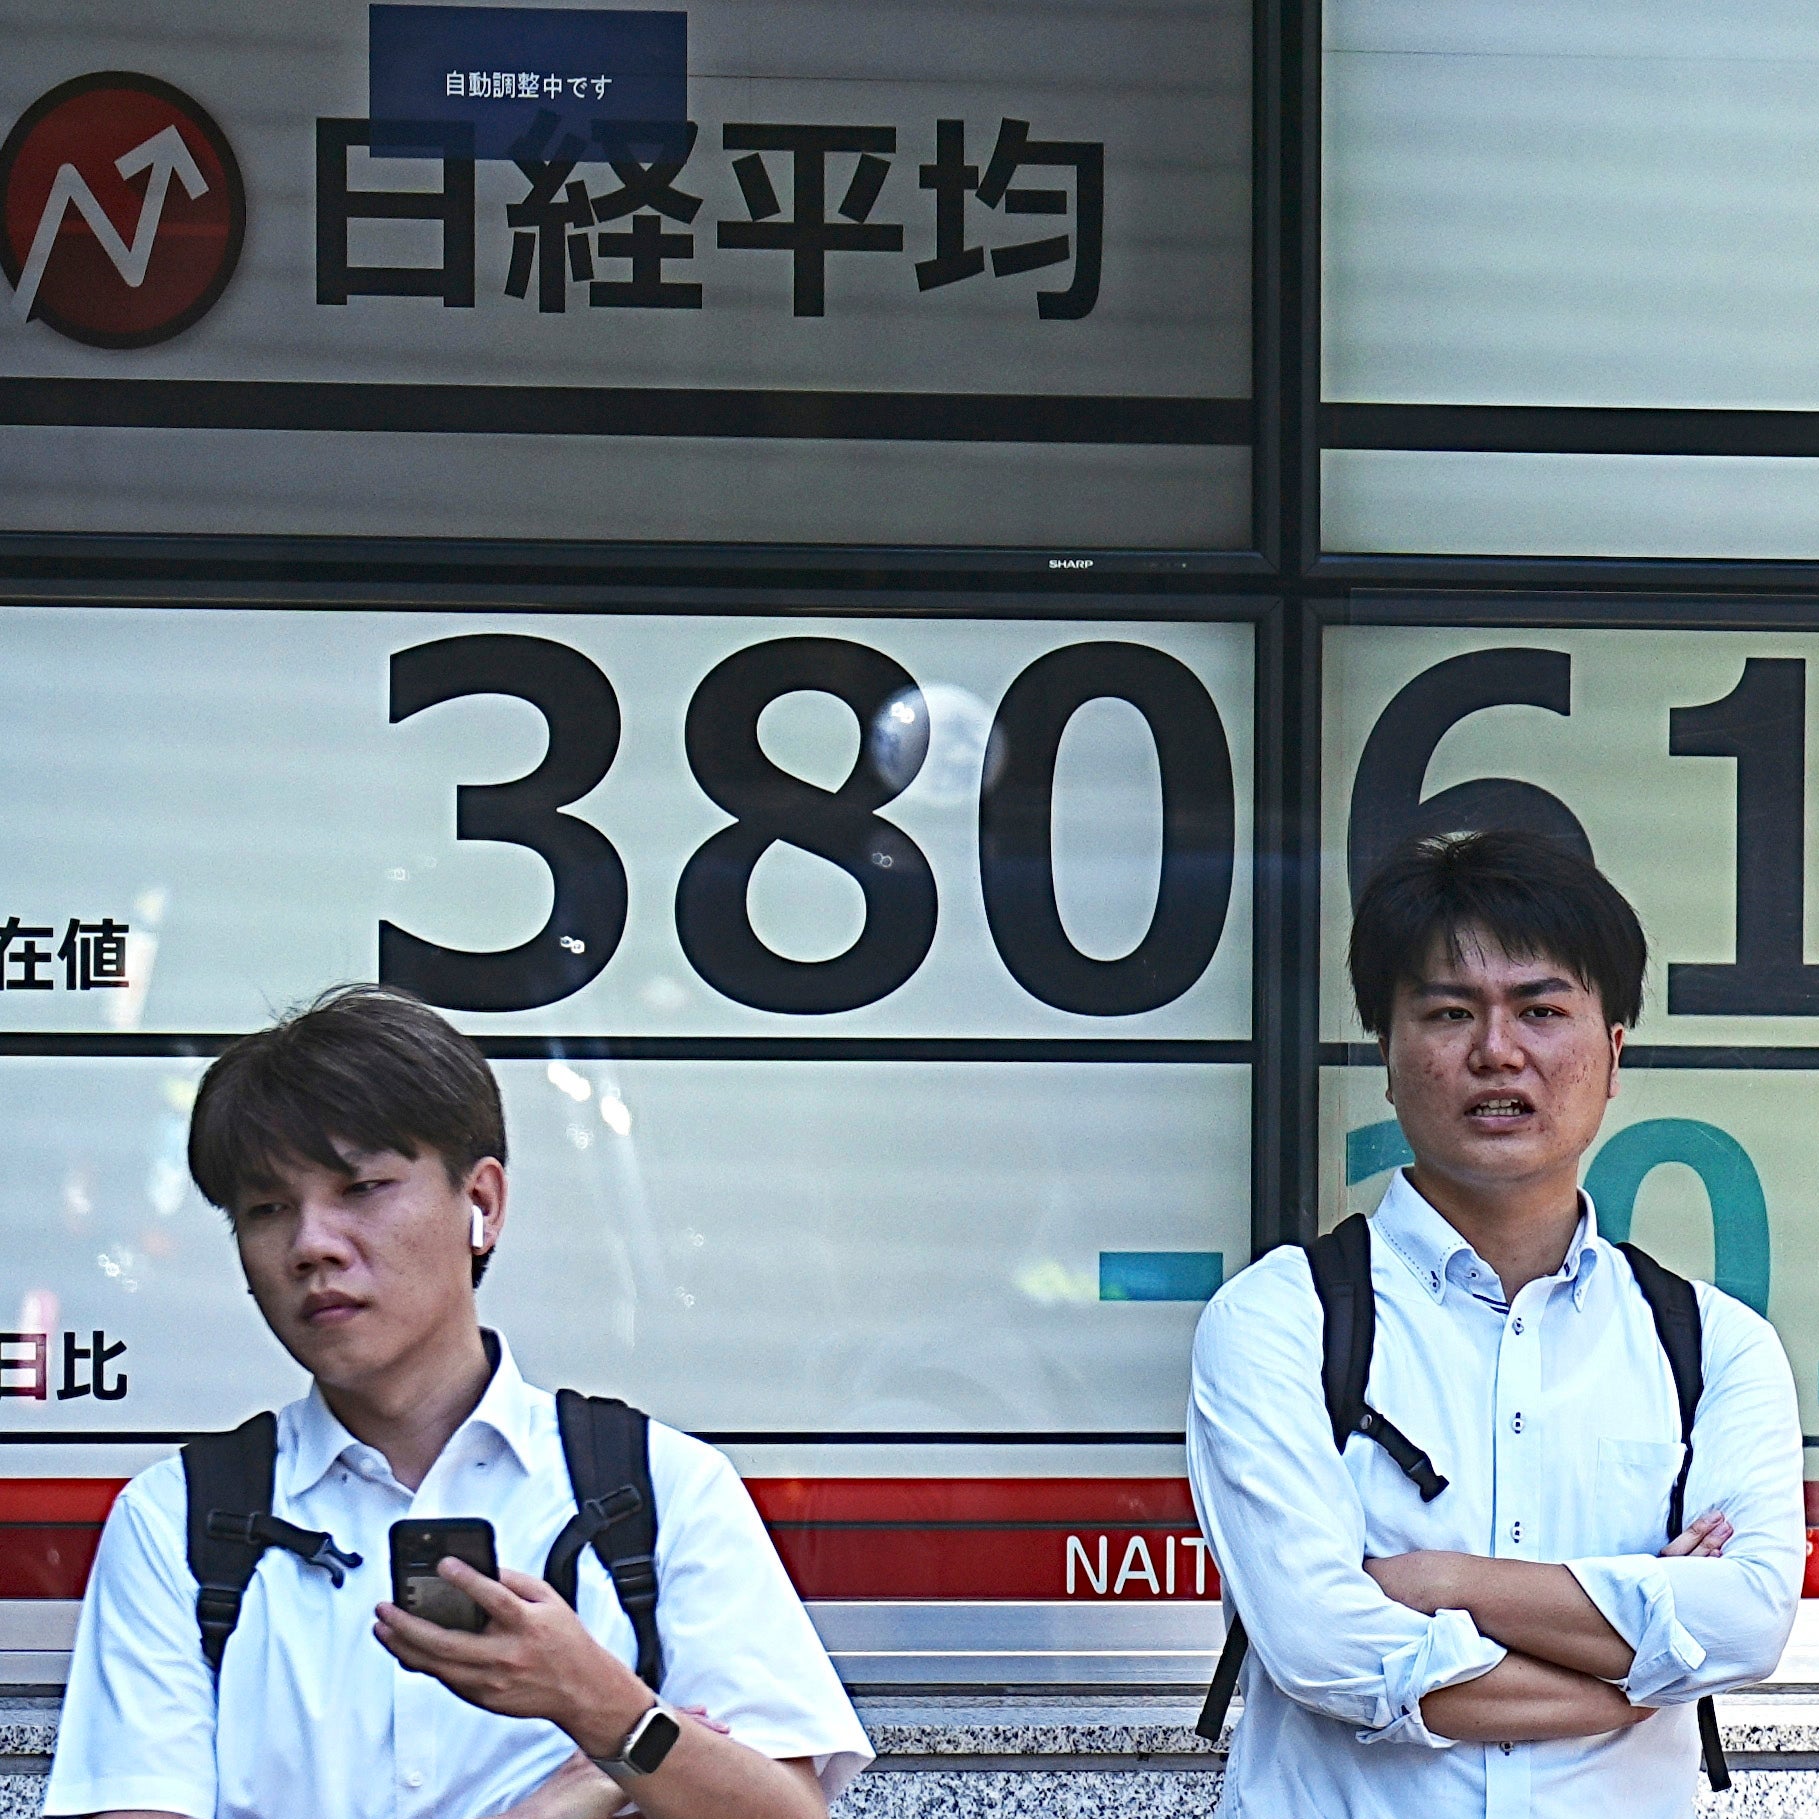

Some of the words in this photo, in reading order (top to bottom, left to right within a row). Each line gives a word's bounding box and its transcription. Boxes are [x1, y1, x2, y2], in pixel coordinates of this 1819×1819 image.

[444, 70, 614, 100] 自動調整中です
[315, 108, 1106, 322] 日経平均
[1049, 558, 1094, 569] SHARP
